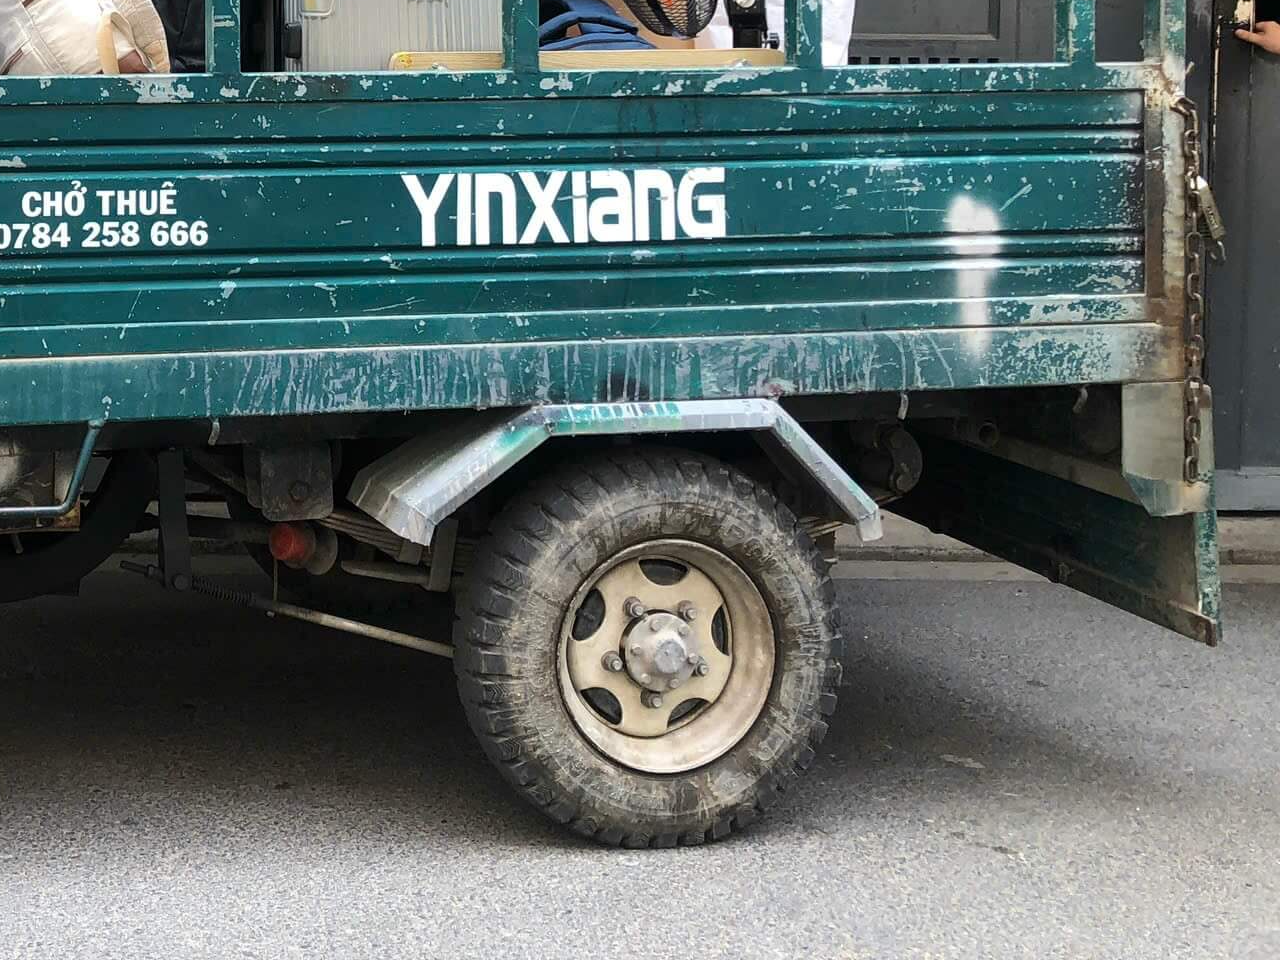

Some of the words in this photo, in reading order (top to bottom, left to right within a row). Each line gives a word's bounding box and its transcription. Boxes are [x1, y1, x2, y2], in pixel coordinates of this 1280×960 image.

[21, 180, 88, 217] CHỞ
[95, 181, 177, 216] THUÊ
[81, 221, 140, 249] 258
[150, 220, 209, 247] 666
